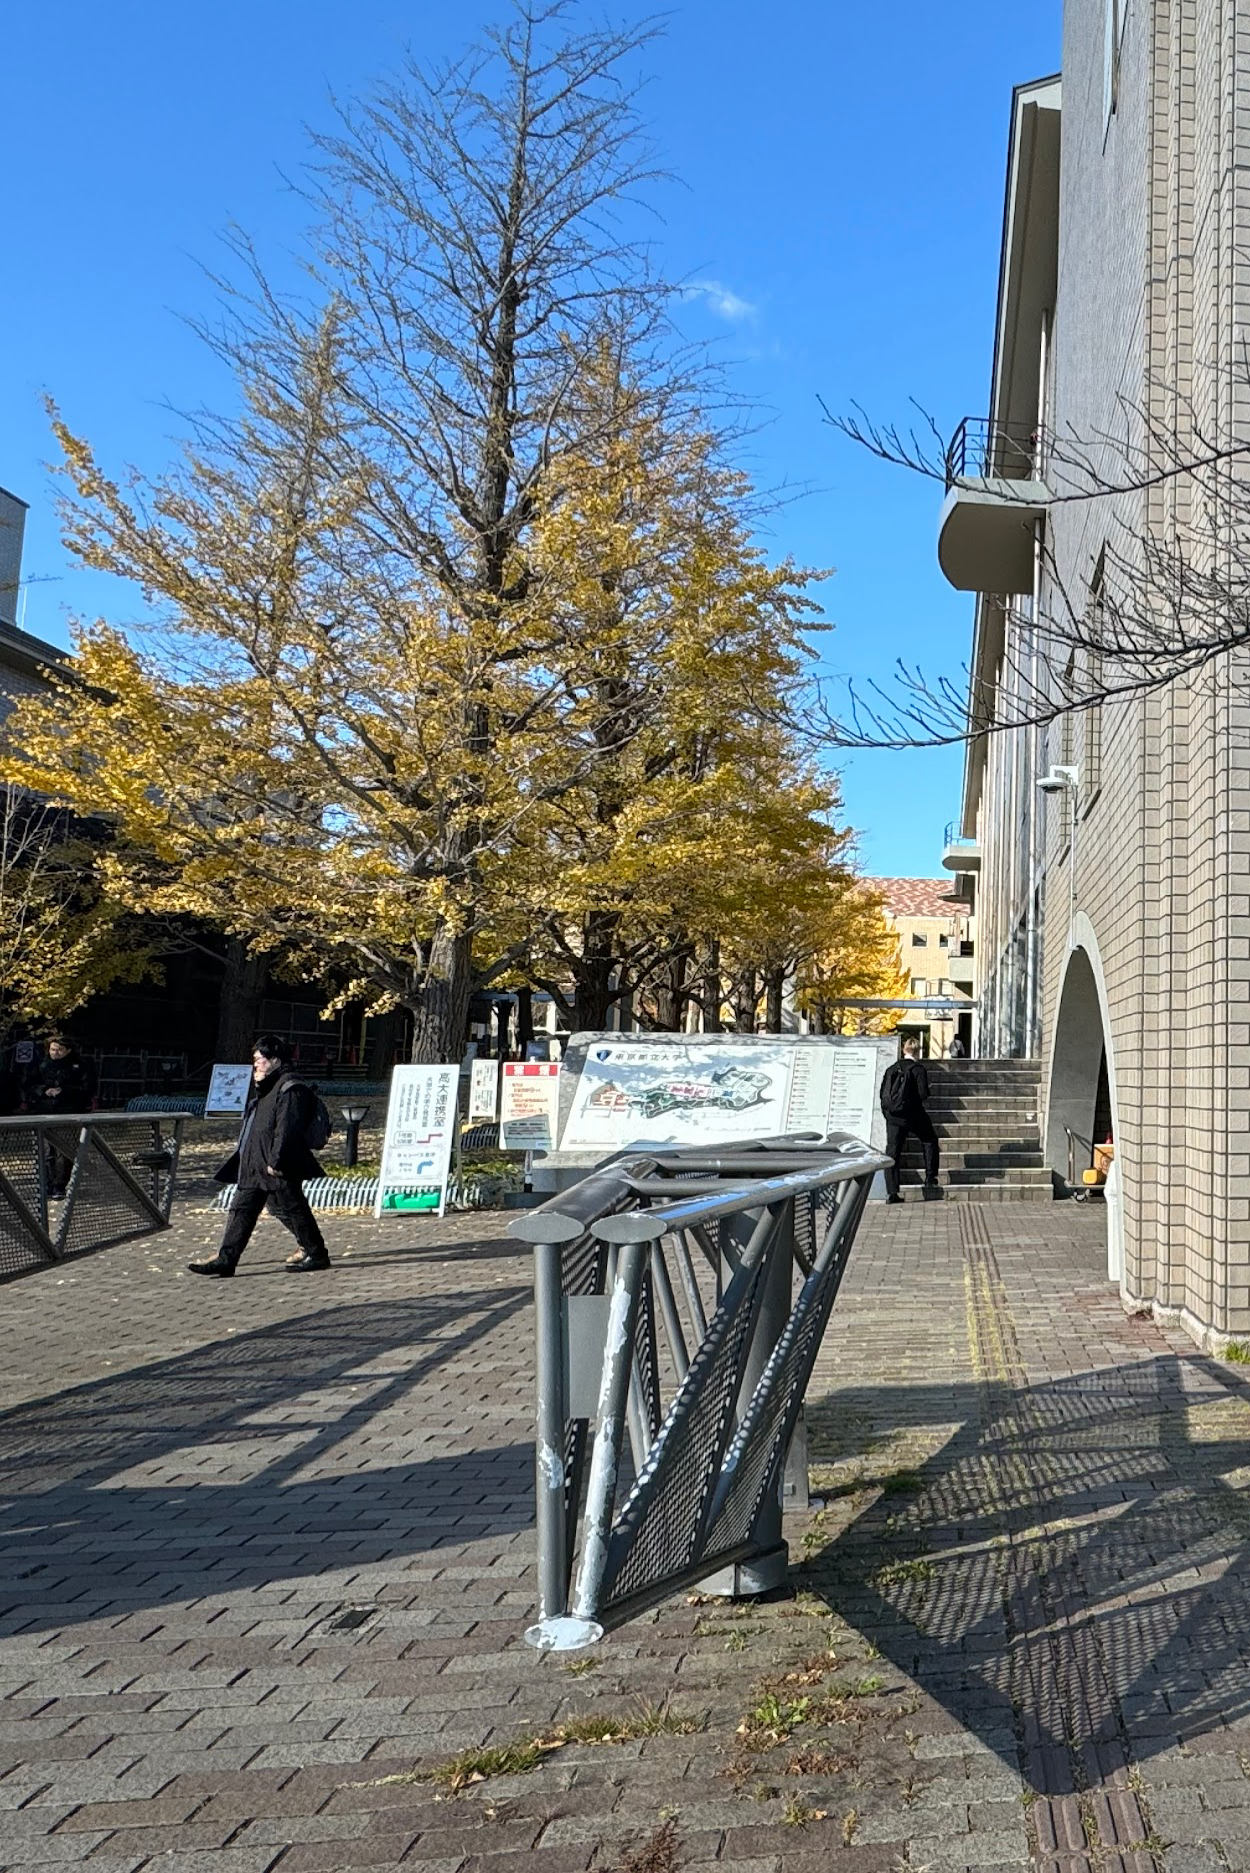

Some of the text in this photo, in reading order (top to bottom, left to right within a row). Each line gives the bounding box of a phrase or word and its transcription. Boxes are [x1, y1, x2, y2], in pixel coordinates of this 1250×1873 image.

[433, 1072, 451, 1127] 高大連携室
